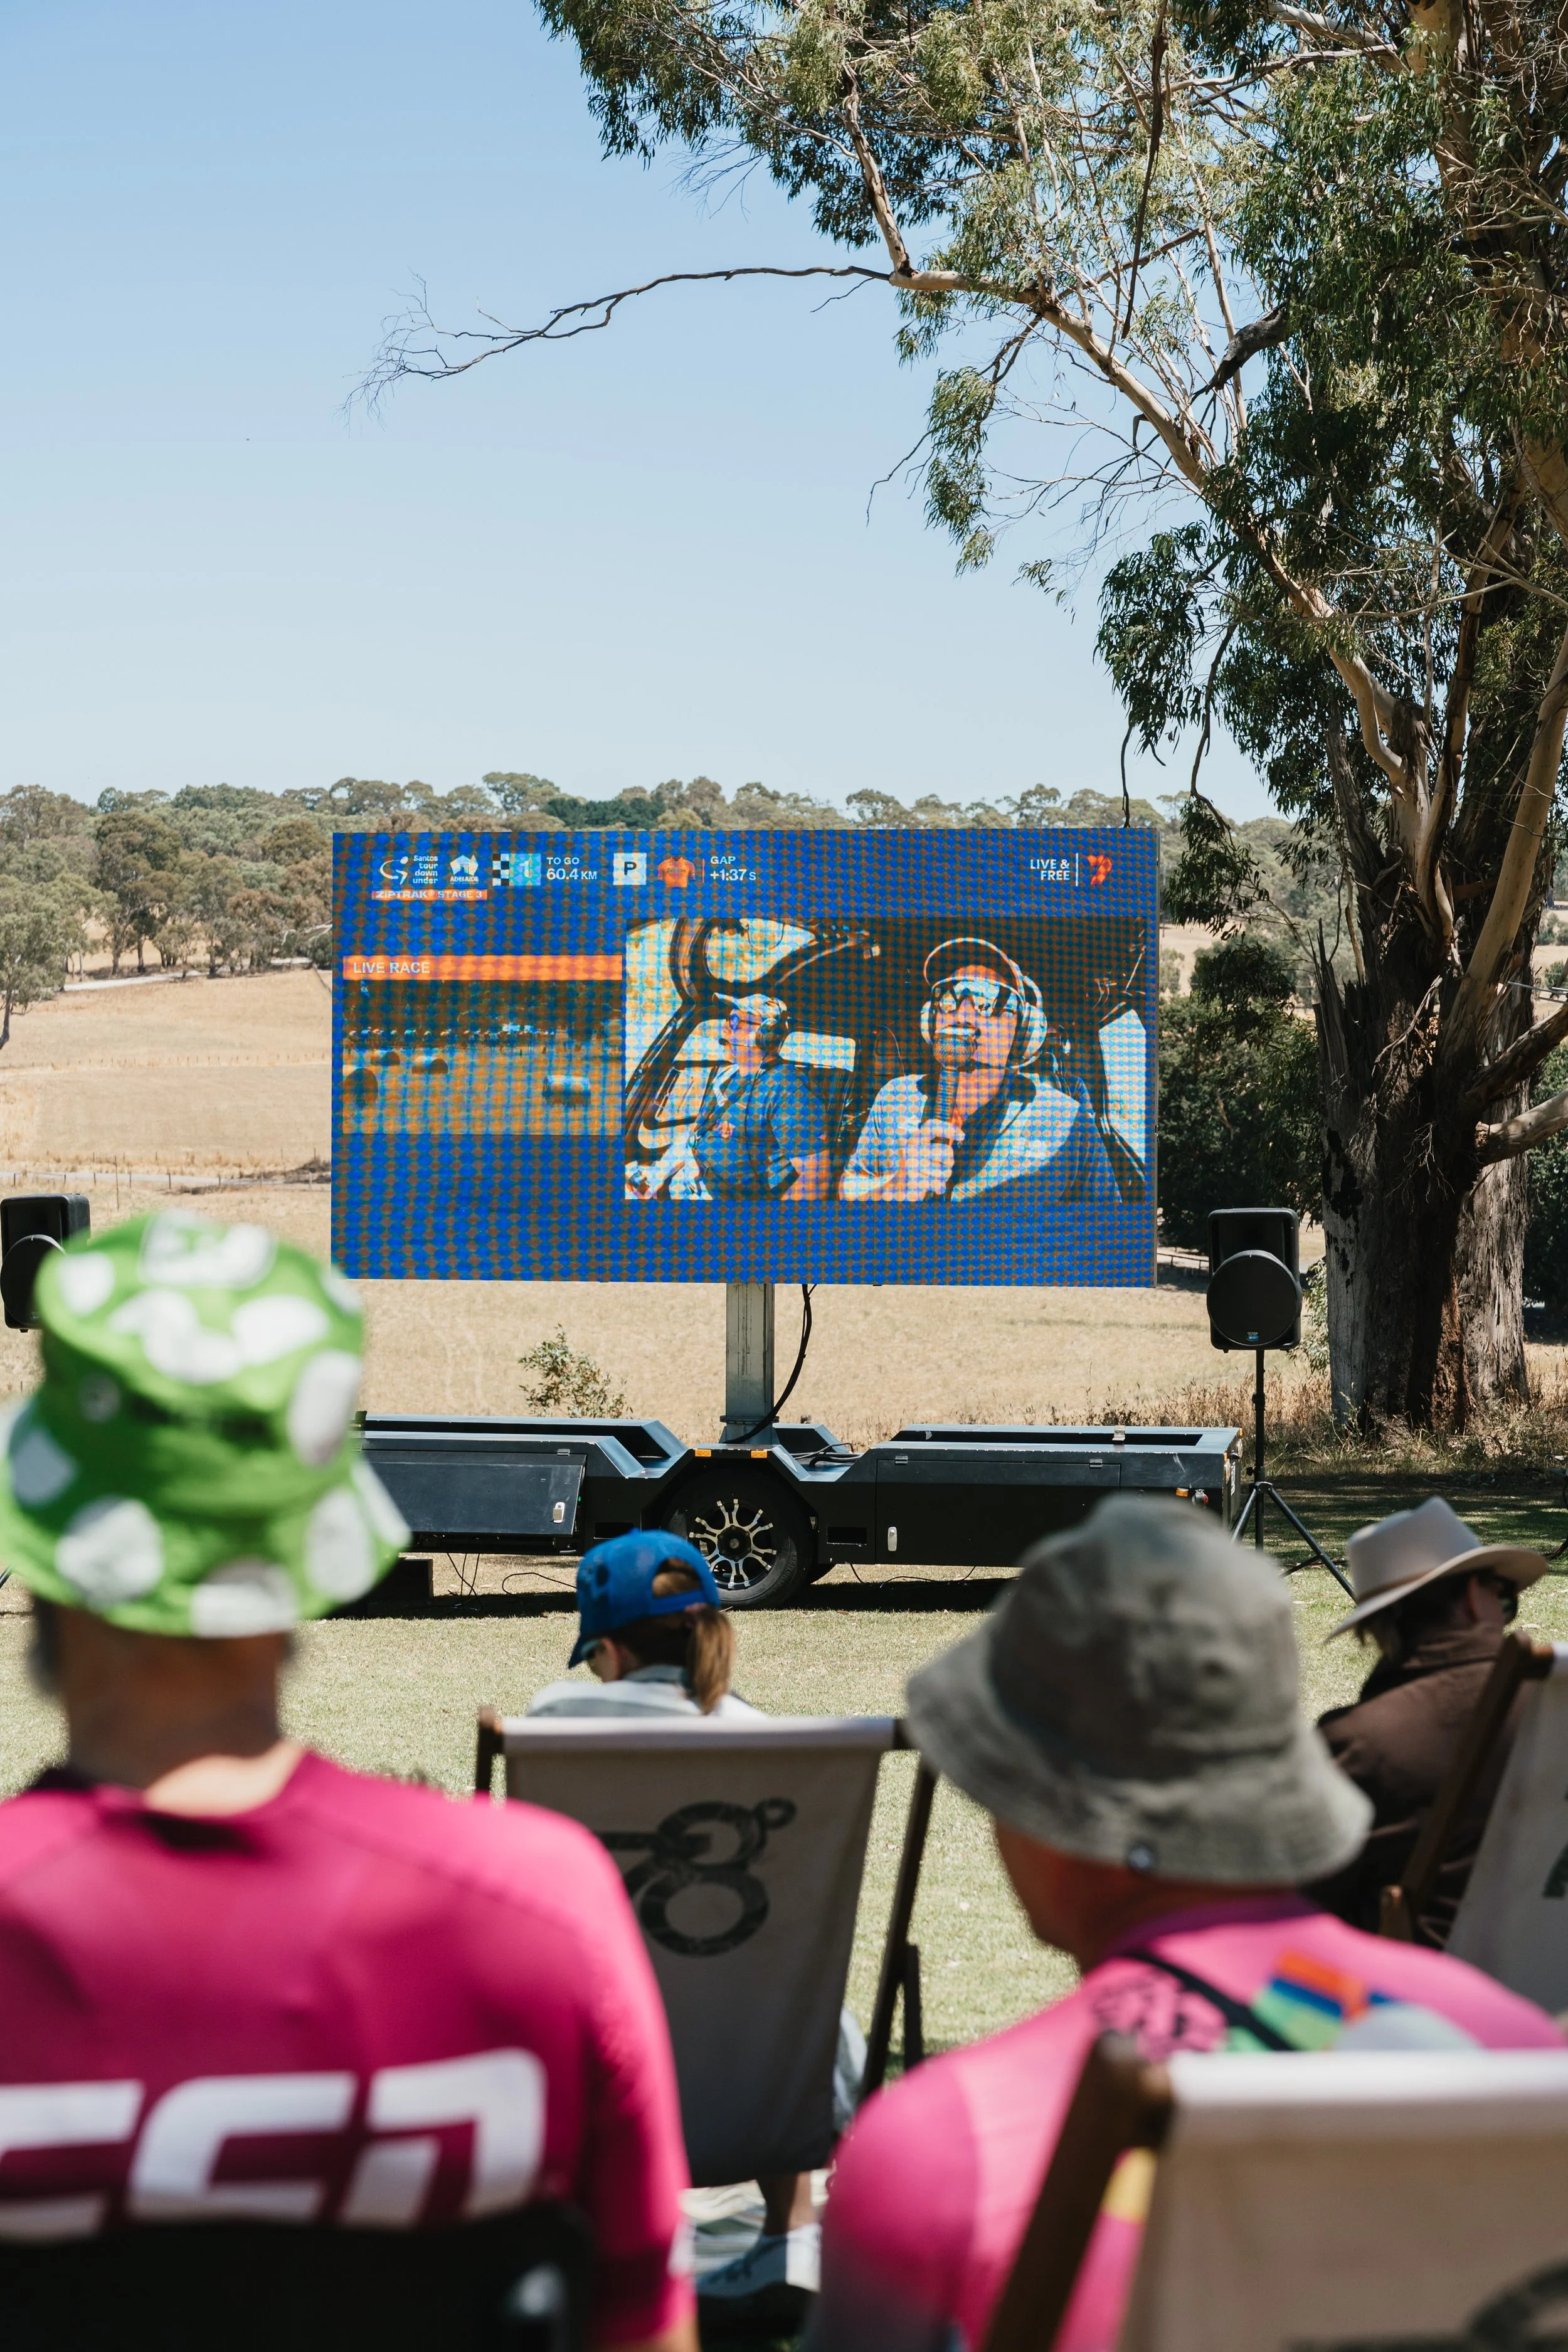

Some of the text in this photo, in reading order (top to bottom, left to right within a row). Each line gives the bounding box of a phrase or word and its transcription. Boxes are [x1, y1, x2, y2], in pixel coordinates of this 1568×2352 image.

[546, 857, 580, 865] TO GO
[710, 856, 736, 864] GAP
[1030, 859, 1070, 869] LIVE &
[546, 867, 597, 880] 60.4 KM
[624, 861, 637, 876] P
[710, 868, 747, 881] +1:37
[1040, 870, 1070, 881] FREE
[438, 890, 474, 899] STAGE
[476, 890, 482, 899] 3
[353, 962, 431, 973] LIVE RACE
